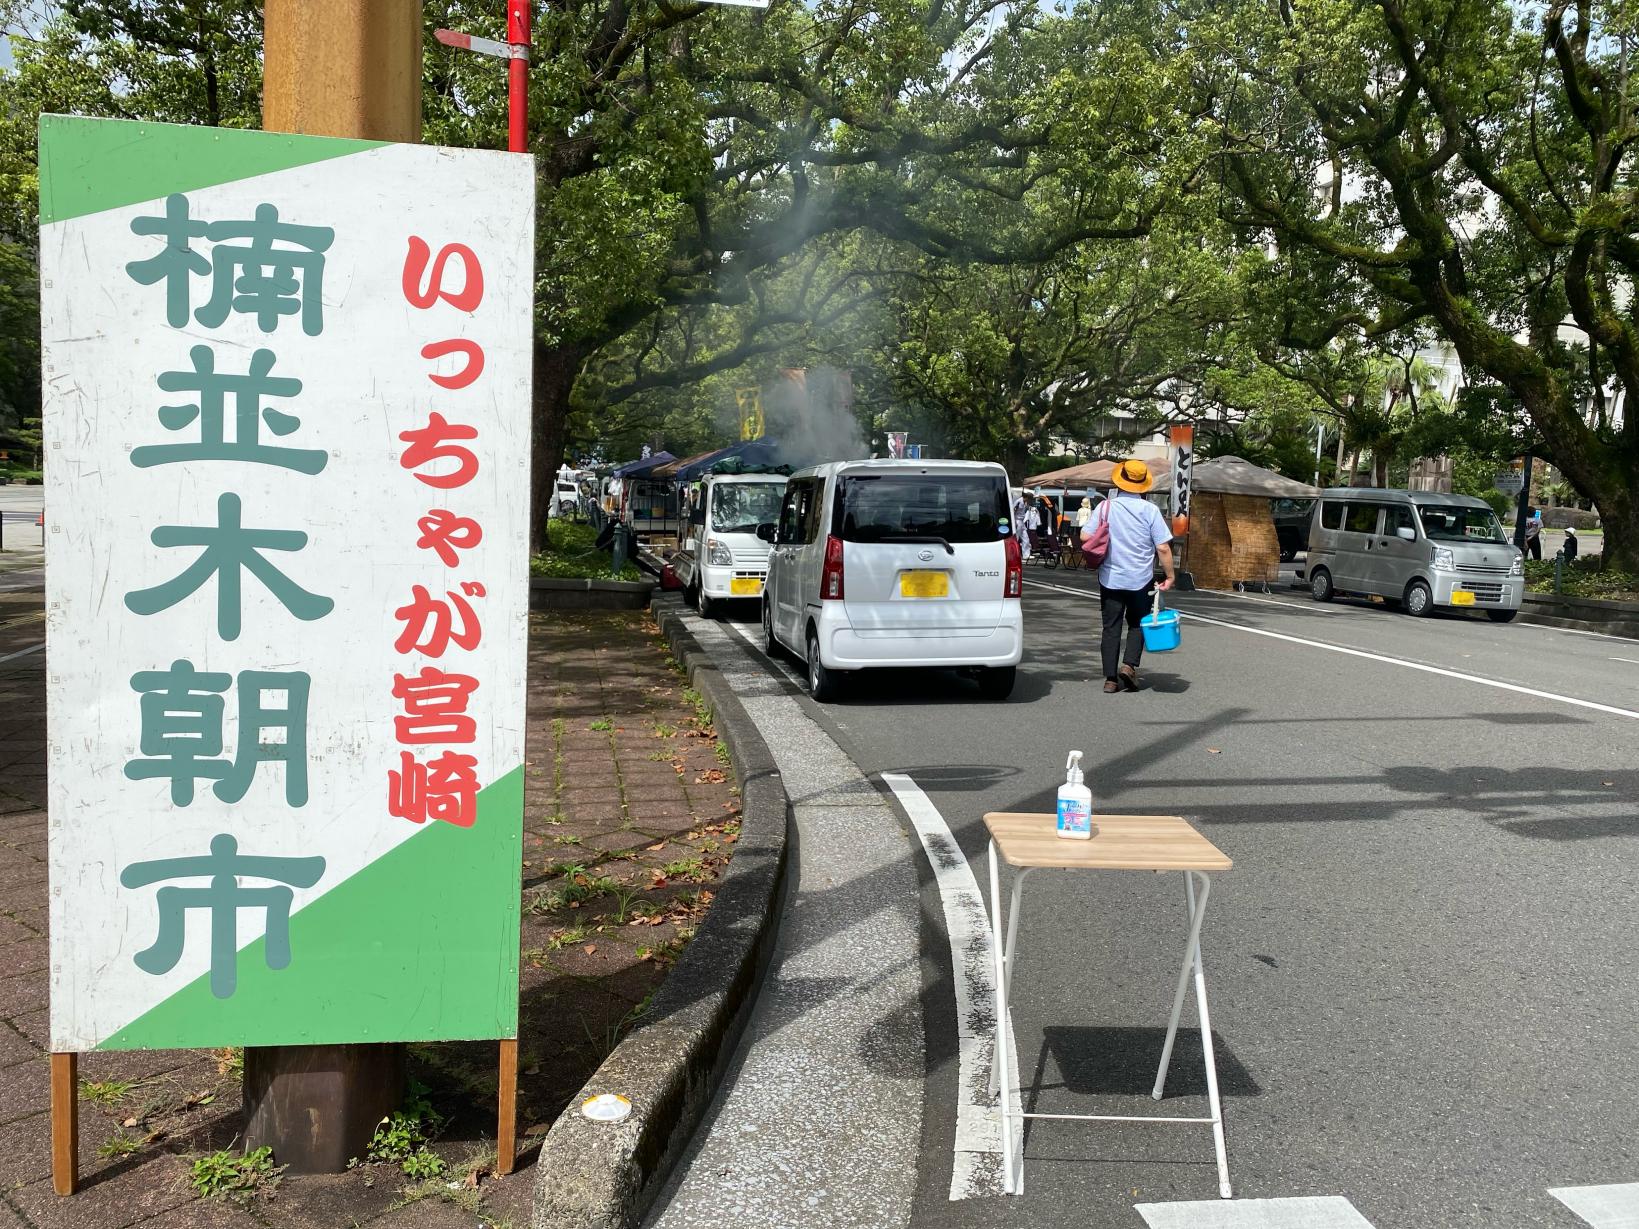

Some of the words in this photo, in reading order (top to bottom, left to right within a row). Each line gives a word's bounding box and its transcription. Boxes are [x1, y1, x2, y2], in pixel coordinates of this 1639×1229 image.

[120, 193, 335, 999] 楠並木朝市
[387, 235, 488, 828] いっちゃが宮崎
